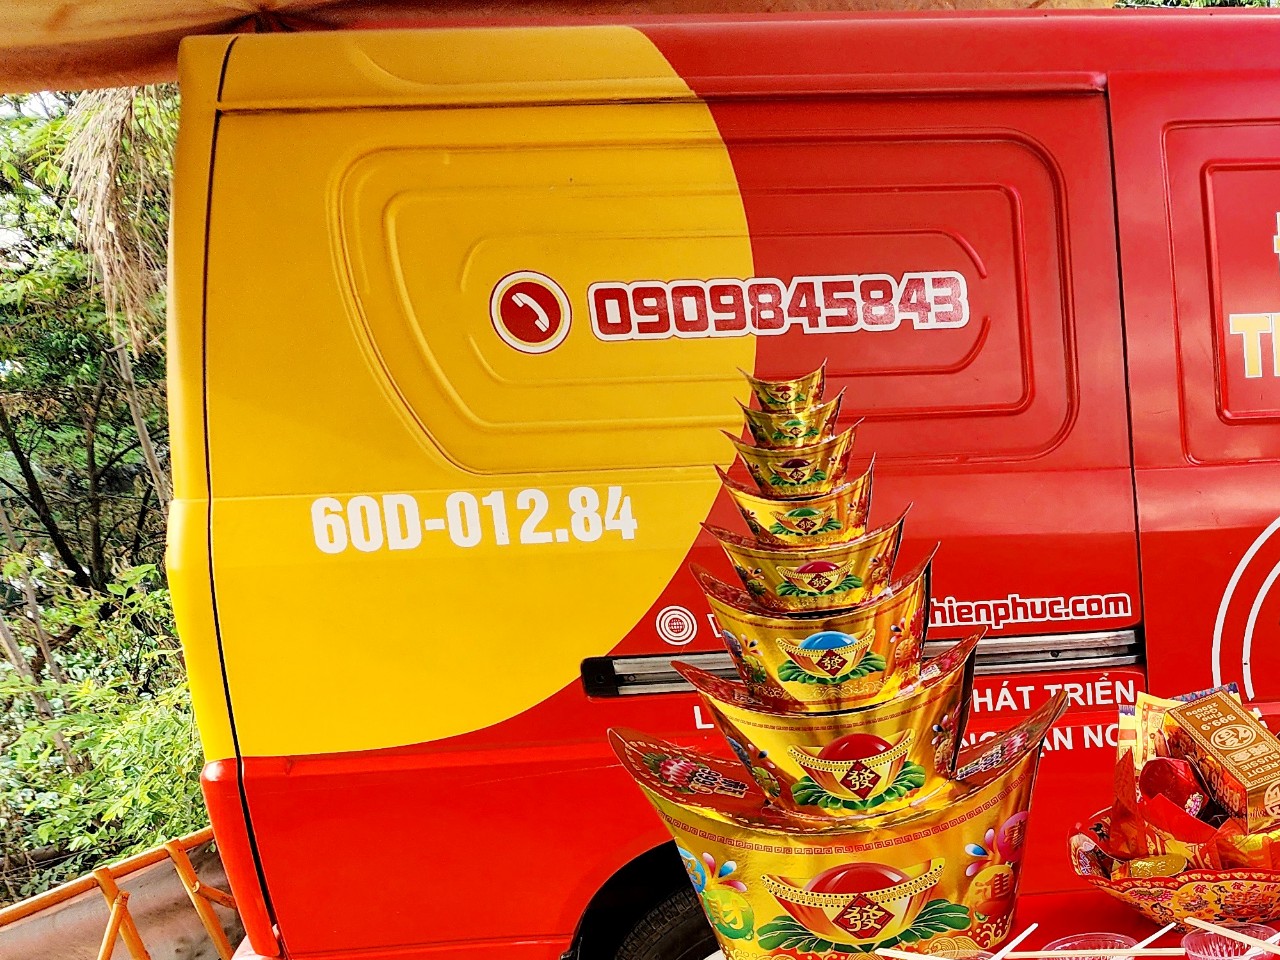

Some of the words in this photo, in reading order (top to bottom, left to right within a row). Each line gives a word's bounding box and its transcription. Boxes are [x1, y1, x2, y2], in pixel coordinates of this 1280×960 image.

[588, 270, 971, 342] 0909845843
[310, 486, 638, 553] 60D-012.84
[930, 593, 1132, 630] hienphuc.com
[972, 681, 1034, 712] HÁT
[1240, 753, 1280, 772] SUSSIE
[848, 768, 874, 790] 發
[844, 903, 884, 932] 發
